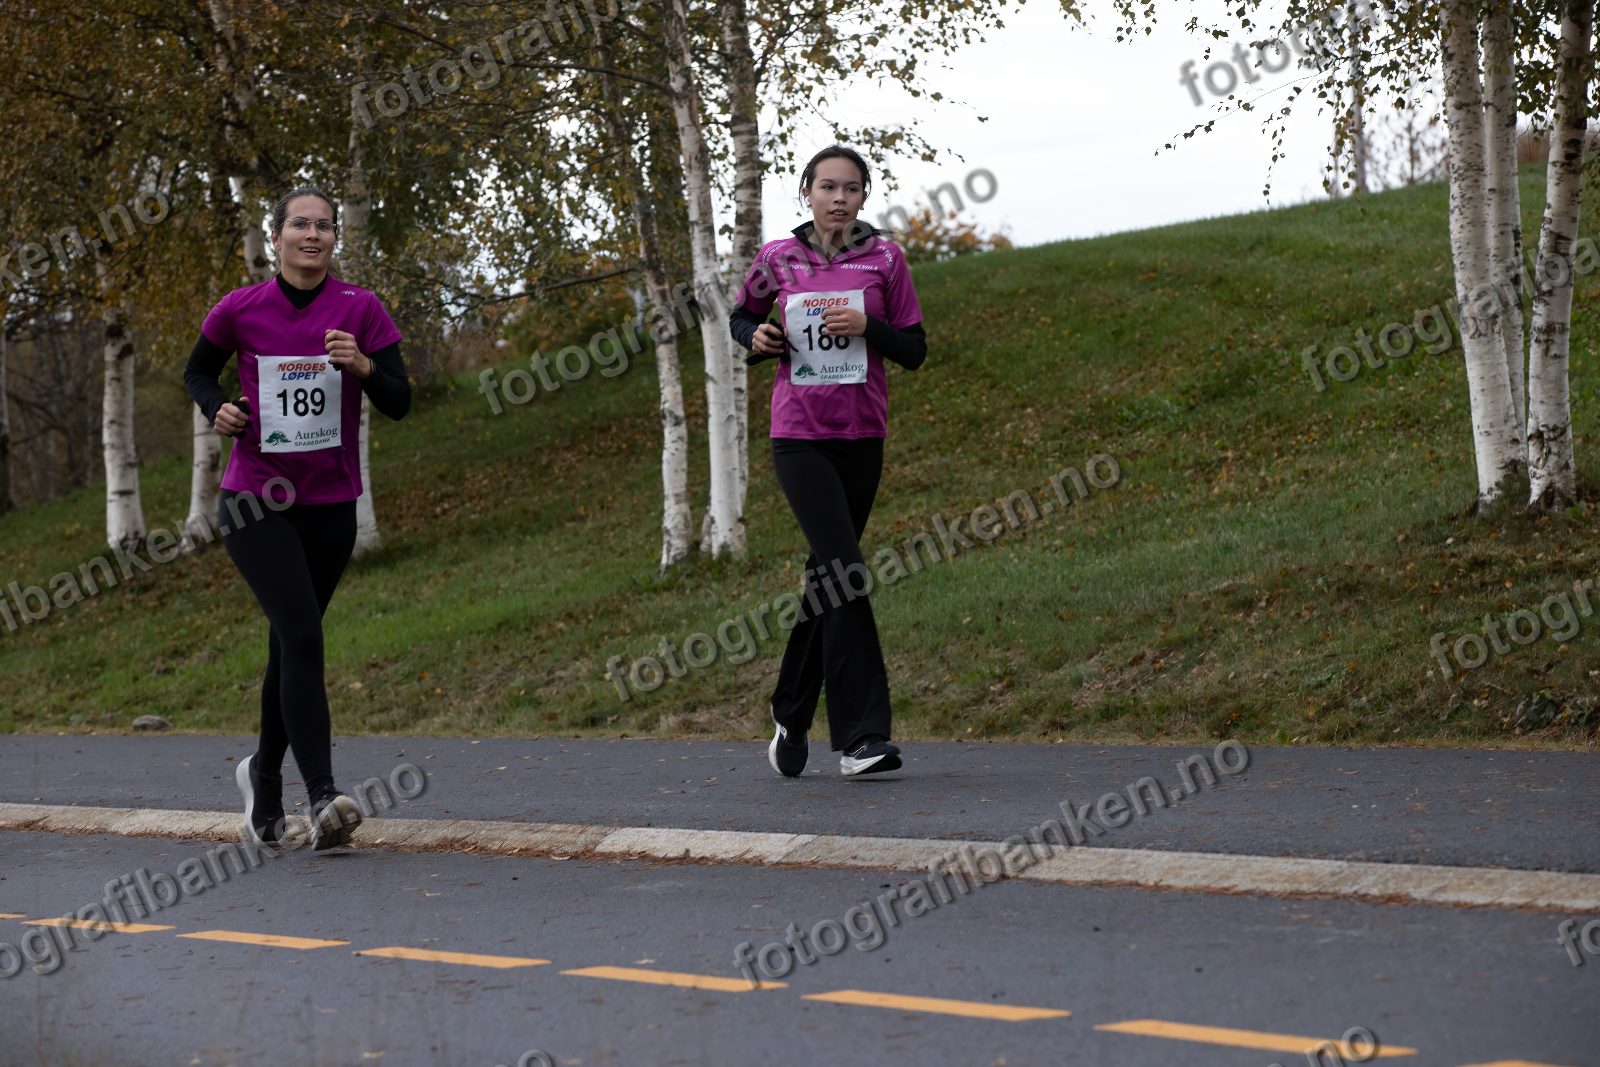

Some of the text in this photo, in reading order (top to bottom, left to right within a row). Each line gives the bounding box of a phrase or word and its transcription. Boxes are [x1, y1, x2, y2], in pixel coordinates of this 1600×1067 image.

[803, 297, 849, 308] NORGES
[277, 362, 326, 372] NORGES
[820, 362, 865, 373] Aurskog
[281, 372, 319, 381] LØPET
[277, 387, 326, 417] 189
[294, 427, 338, 440] Aurskog
